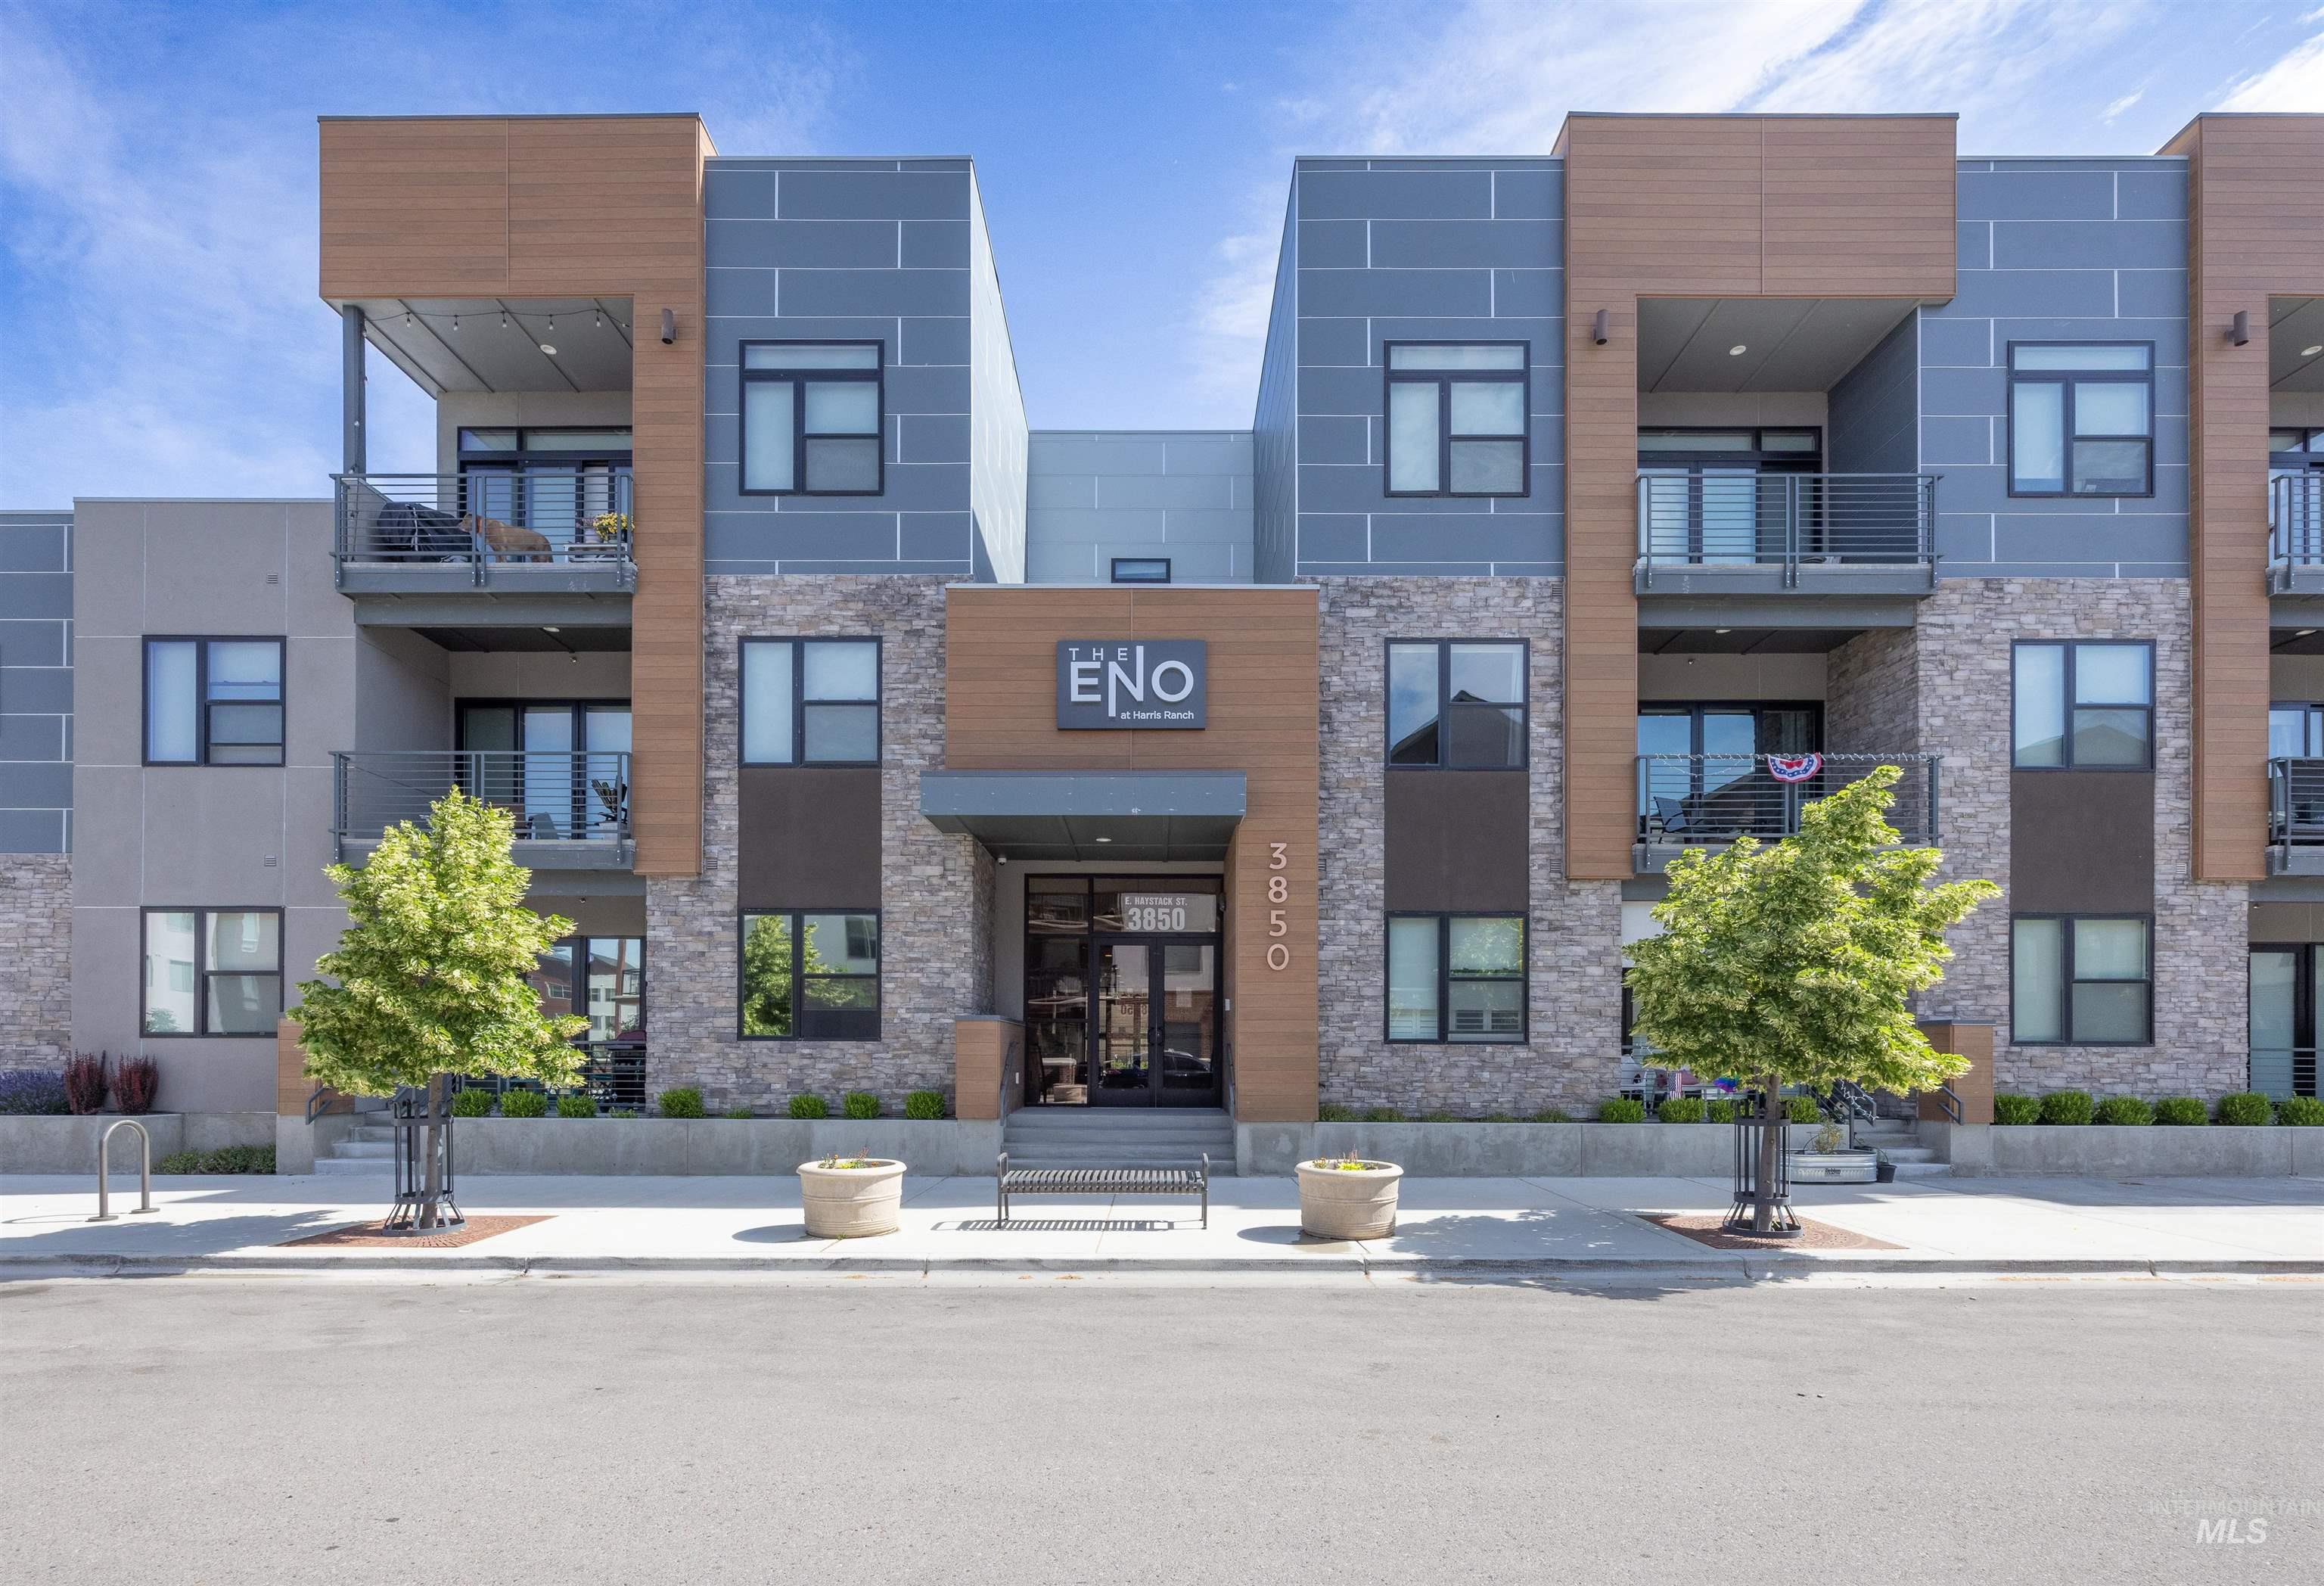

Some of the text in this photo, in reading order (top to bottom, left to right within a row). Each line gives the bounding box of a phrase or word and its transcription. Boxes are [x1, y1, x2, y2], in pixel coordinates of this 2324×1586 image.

[1068, 648, 1128, 661] THE
[1070, 645, 1194, 717] ENO
[1120, 711, 1194, 720] at Harris Ranch
[1125, 897, 1188, 906] E. HAYSTACK ST.
[1266, 842, 1290, 971] 3850
[1128, 907, 1185, 931] 3850
